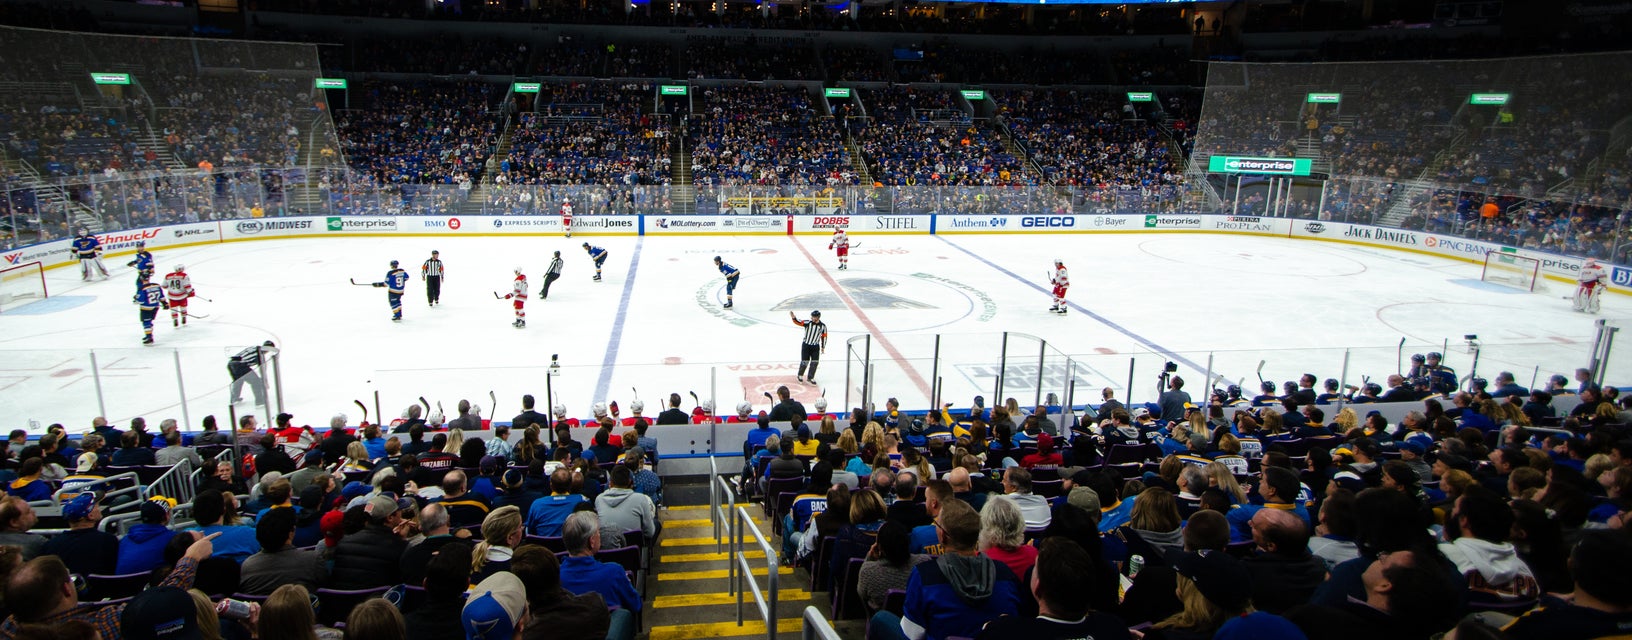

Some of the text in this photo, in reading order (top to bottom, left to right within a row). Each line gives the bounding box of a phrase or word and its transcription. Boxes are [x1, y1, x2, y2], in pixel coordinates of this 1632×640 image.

[1229, 160, 1293, 170] enterprise
[265, 220, 313, 231] MIDWEST
[330, 217, 396, 229] enterprise
[504, 219, 532, 227] EXPRESS
[570, 217, 633, 228] Edward Jones
[670, 219, 717, 229] MOLottery.com
[813, 216, 850, 225] DOBBS
[876, 215, 918, 230] STIFEL
[950, 217, 987, 228] Anthem
[1021, 216, 1075, 228] GEICO
[1105, 217, 1127, 226] Bayer
[1149, 215, 1200, 226] enterprise
[242, 222, 258, 231] FOX
[1216, 221, 1272, 232] PRO PLAN
[96, 227, 161, 245] chnucks
[1344, 224, 1371, 239] JACK
[1375, 228, 1417, 245] DANIEL'S
[1439, 238, 1498, 257] PNC BANK
[169, 279, 181, 290] 48
[726, 363, 802, 372] OYOTA
